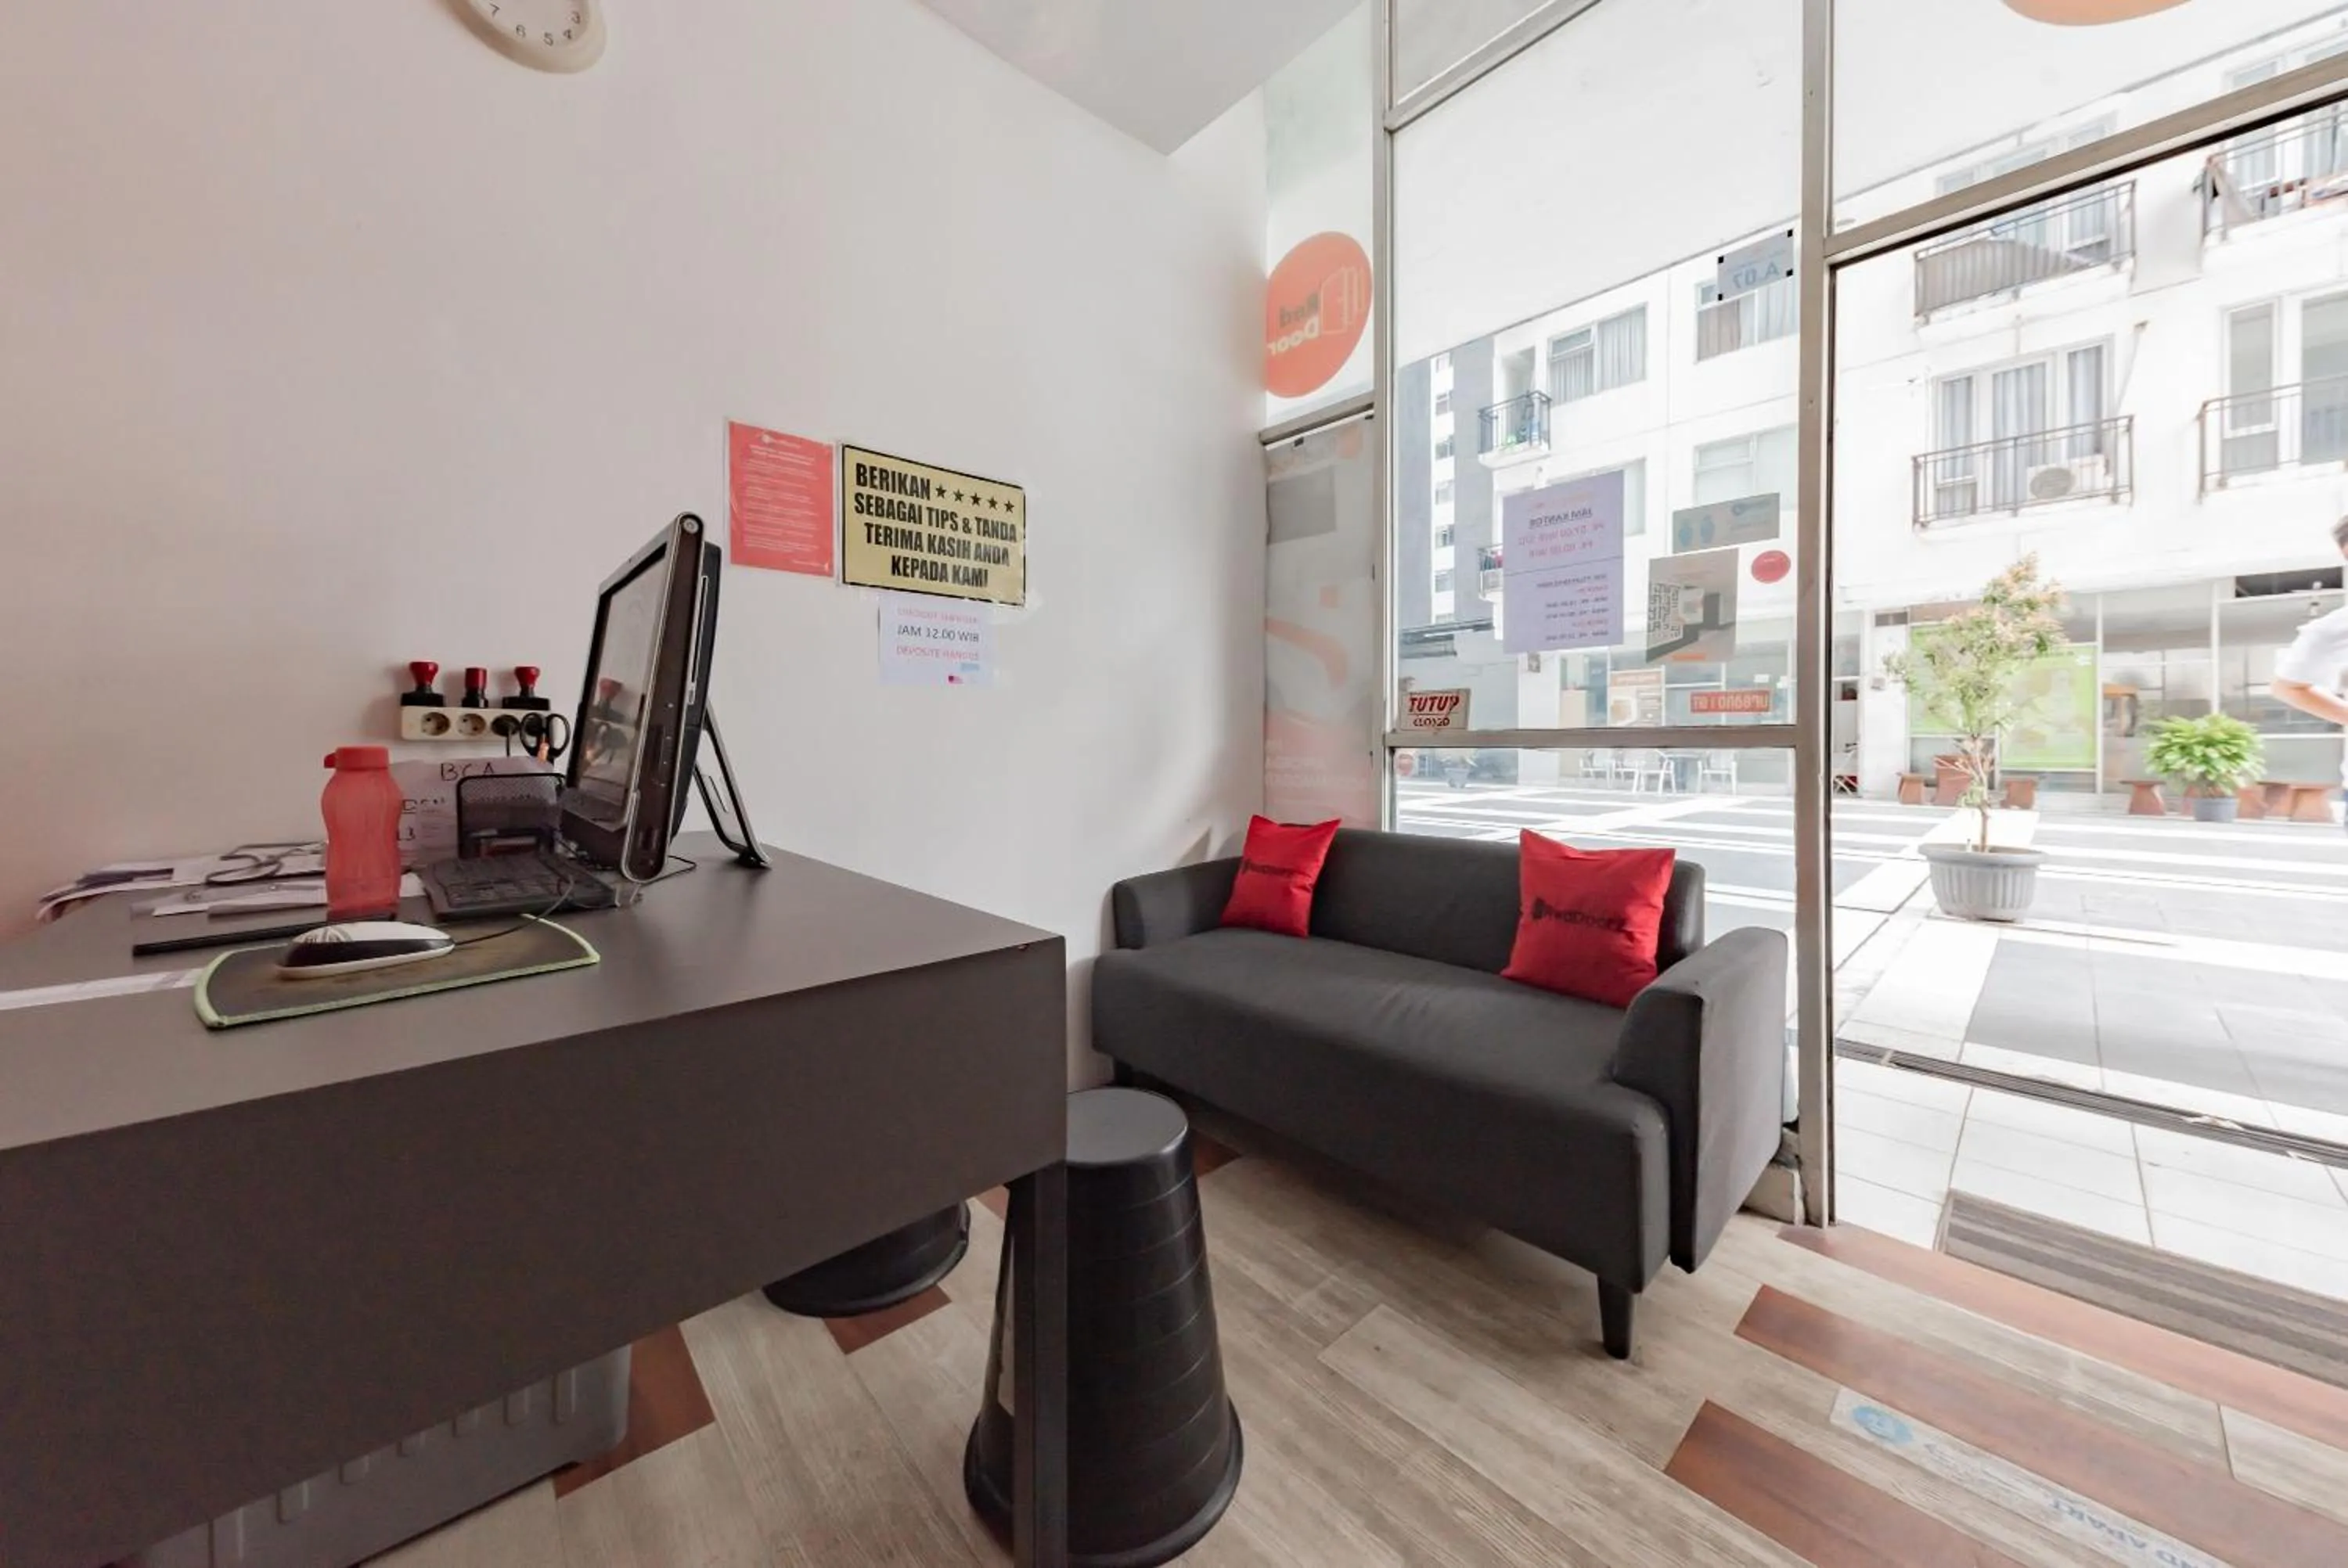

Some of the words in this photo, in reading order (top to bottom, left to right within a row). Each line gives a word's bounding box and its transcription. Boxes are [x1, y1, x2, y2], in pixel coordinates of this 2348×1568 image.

[489, 3, 501, 18] 7
[571, 11, 582, 24] 3
[543, 32, 554, 46] 5
[855, 462, 931, 501] BERIKAN
[854, 492, 923, 524] SEBAGAI
[927, 506, 959, 532] TIPS
[962, 517, 972, 534] &
[974, 516, 1017, 543] TANDA
[864, 522, 924, 552] TERIMA
[927, 533, 971, 560] KASIH
[974, 542, 1010, 566] ANDA
[891, 555, 949, 583] KEPADA
[953, 564, 989, 588] KAMI
[898, 625, 922, 637] JAM
[926, 628, 956, 641] 12.00
[957, 631, 979, 642] WIB
